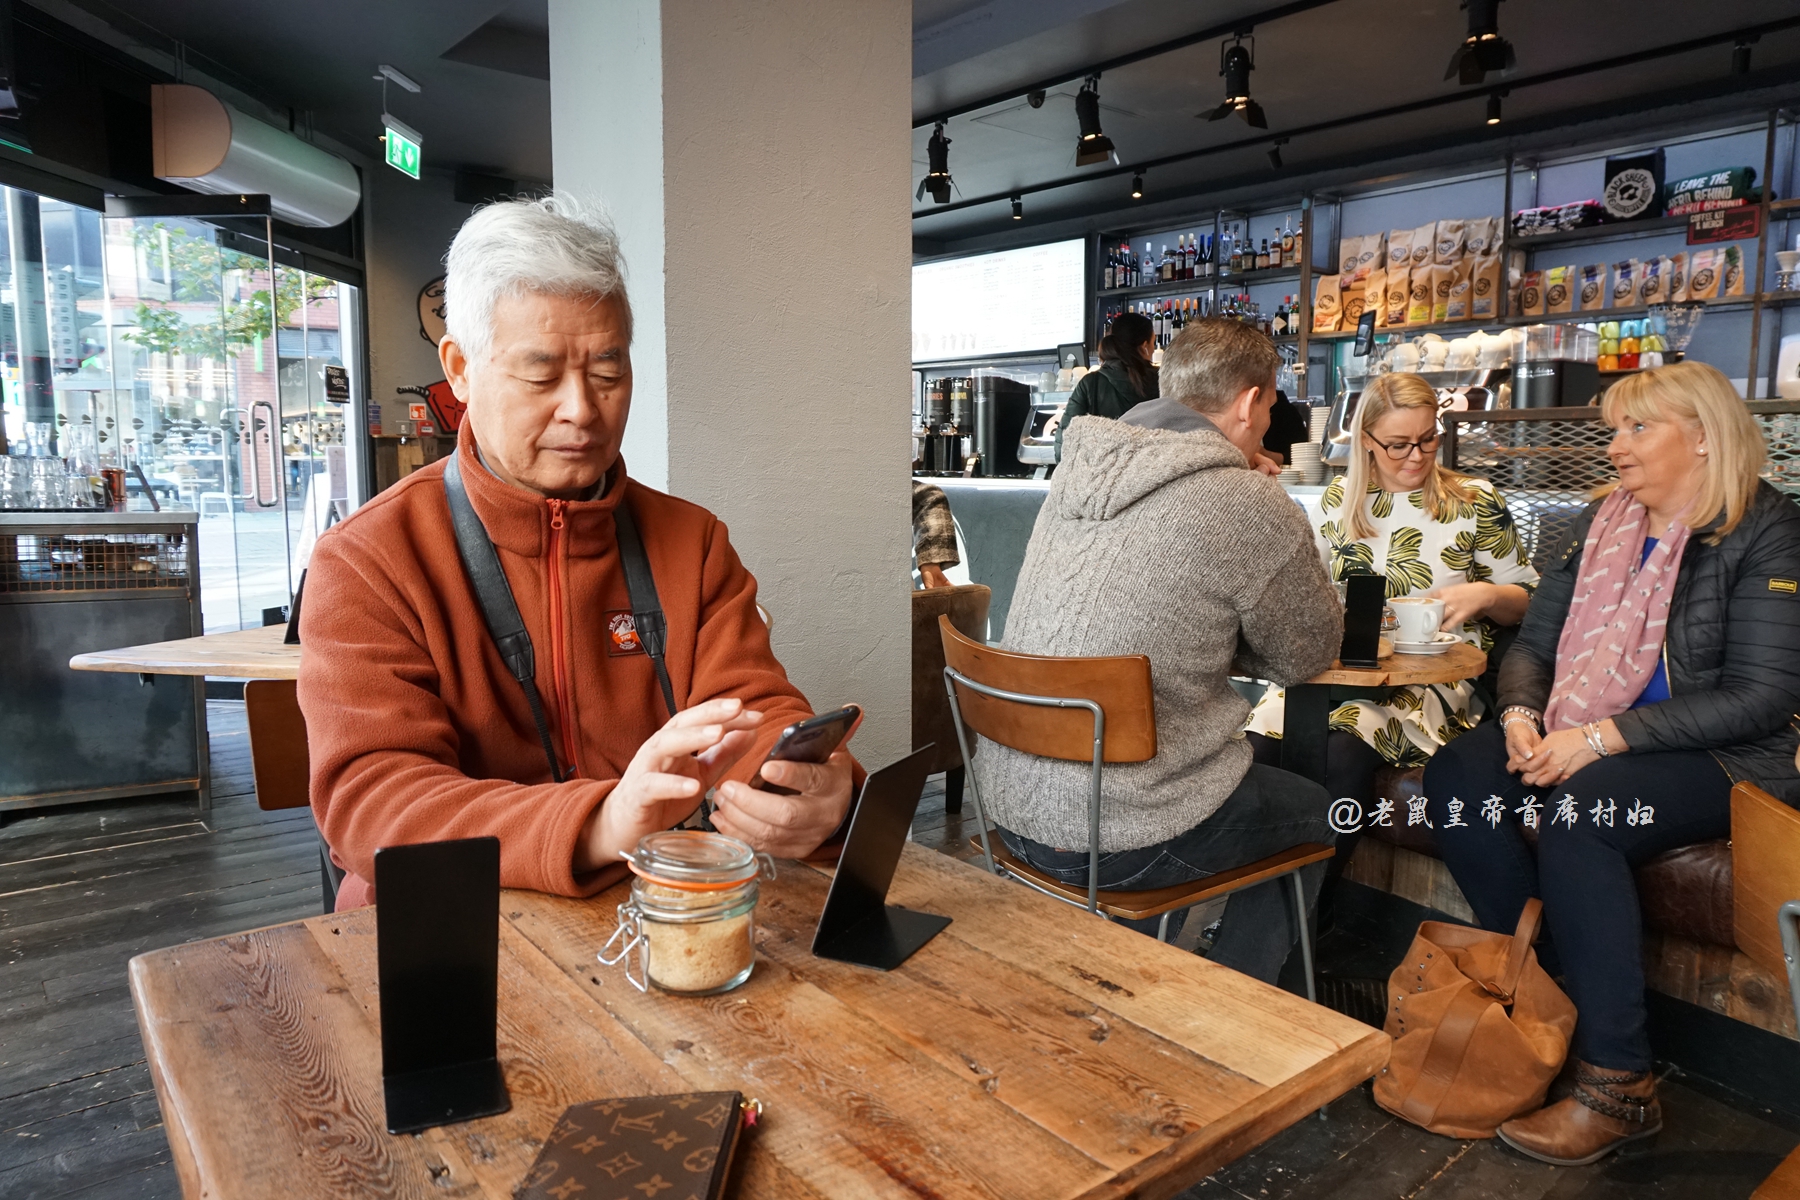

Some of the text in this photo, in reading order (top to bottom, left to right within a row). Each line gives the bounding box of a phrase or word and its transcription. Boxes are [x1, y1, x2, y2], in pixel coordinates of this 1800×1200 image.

[1607, 176, 1625, 199] BLACK
[1625, 172, 1647, 184] SHEEP
[1674, 170, 1731, 193] LEAVE THE
[1694, 186, 1733, 201] BEHIND
[1690, 210, 1726, 224] COFFEE KIT
[1702, 219, 1725, 230] MERCH
